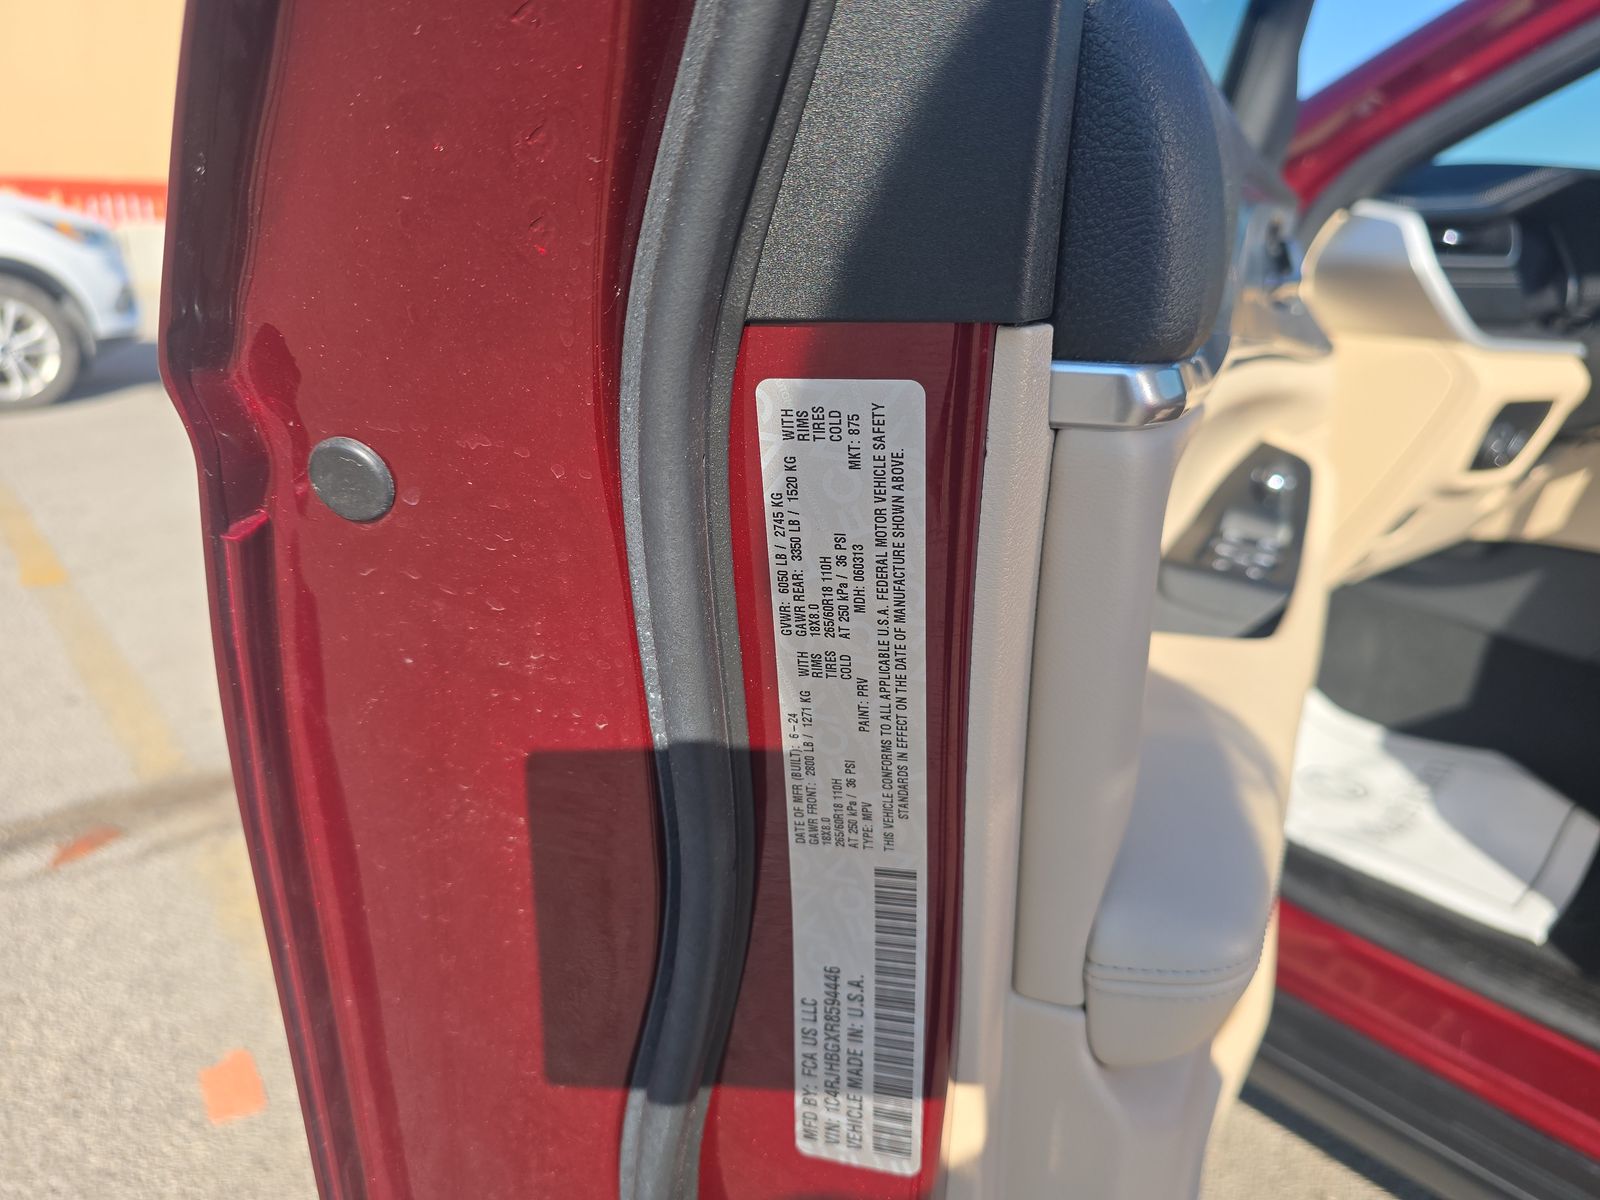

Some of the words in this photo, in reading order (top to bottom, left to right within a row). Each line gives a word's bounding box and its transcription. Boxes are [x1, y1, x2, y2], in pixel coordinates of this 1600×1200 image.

[781, 409, 794, 440] WITH
[796, 410, 810, 441] RIMS
[812, 406, 826, 442] TIRES
[829, 410, 842, 442] COLD
[848, 414, 860, 435] 875
[872, 403, 885, 450] SAFETY
[784, 456, 796, 471] KG
[848, 440, 861, 470] MKT:
[873, 455, 886, 503] VEHICLE
[891, 448, 904, 491] ABOVE.
[771, 492, 783, 507] KG
[786, 476, 798, 501] 1520
[773, 512, 785, 537] 2745
[788, 520, 800, 532] LB
[874, 508, 888, 547] MOTOR
[892, 496, 904, 538] SHOWN
[790, 537, 802, 561] 3350
[834, 533, 846, 550] PSI
[776, 554, 787, 566] LB
[820, 556, 832, 582] 110H
[836, 555, 847, 566] 36
[852, 544, 864, 582] 060313
[778, 570, 789, 594] 6050
[793, 570, 805, 601] REAR:
[876, 552, 888, 600] FEDERAL
[892, 542, 906, 623] MANUFACTURE
[837, 583, 849, 601] kPa
[853, 586, 866, 613] MDH:
[780, 602, 792, 636] GVWR:
[794, 606, 807, 637] GAWR
[808, 604, 821, 637] 18X8.0
[822, 586, 835, 638] 265/60R18
[838, 605, 850, 622] 250
[877, 606, 889, 636] U.S.A.
[838, 626, 850, 639] AT
[894, 628, 906, 640] OF
[797, 651, 809, 677] WITH
[811, 653, 823, 678] RIMS
[825, 650, 837, 678] TIRES
[840, 654, 852, 680] COLD
[894, 644, 906, 670] DATE
[878, 640, 890, 700] APPLICABLE
[800, 690, 810, 702] KG
[857, 678, 868, 697] PRV
[894, 674, 906, 693] THE
[880, 703, 891, 721] ALL
[896, 697, 907, 710] ON
[802, 708, 812, 727] 1271
[858, 701, 869, 732] PAINT:
[880, 724, 892, 736] TO
[896, 714, 908, 748] EFFECT
[803, 742, 814, 752] LB
[897, 752, 908, 761] IN
[791, 746, 804, 780] (BUILT):
[804, 756, 815, 776] 2800
[845, 760, 855, 774] PSI
[881, 740, 892, 790] CONFORMS
[792, 784, 803, 803] MFR
[832, 778, 842, 799] 110H
[846, 778, 856, 788] 36
[898, 765, 909, 820] STANDARDS
[806, 782, 818, 814] FRONT:
[846, 801, 857, 816] kPa
[794, 807, 804, 817] OF
[862, 802, 872, 820] MPV
[882, 794, 894, 828] VEHICLE
[795, 821, 805, 844] DATE
[808, 818, 819, 845] GAWR
[821, 818, 831, 845] 18X8.0
[834, 804, 845, 846] 265/60R18
[848, 820, 858, 834] 250
[863, 825, 874, 850] TYPE:
[848, 838, 858, 848] AT
[883, 832, 894, 851] THIS
[847, 975, 864, 1018] U.S.A.
[801, 997, 817, 1022] LLC
[801, 1028, 817, 1046] US
[824, 966, 840, 1112] 1C4RJHBGXR8594446
[848, 1024, 864, 1042] IN:
[802, 1053, 817, 1077] FCA
[847, 1048, 863, 1089] MADE
[802, 1084, 817, 1106] BY:
[802, 1112, 817, 1141] MFD
[825, 1118, 840, 1145] VIN:
[847, 1094, 863, 1150] VEHICLE
